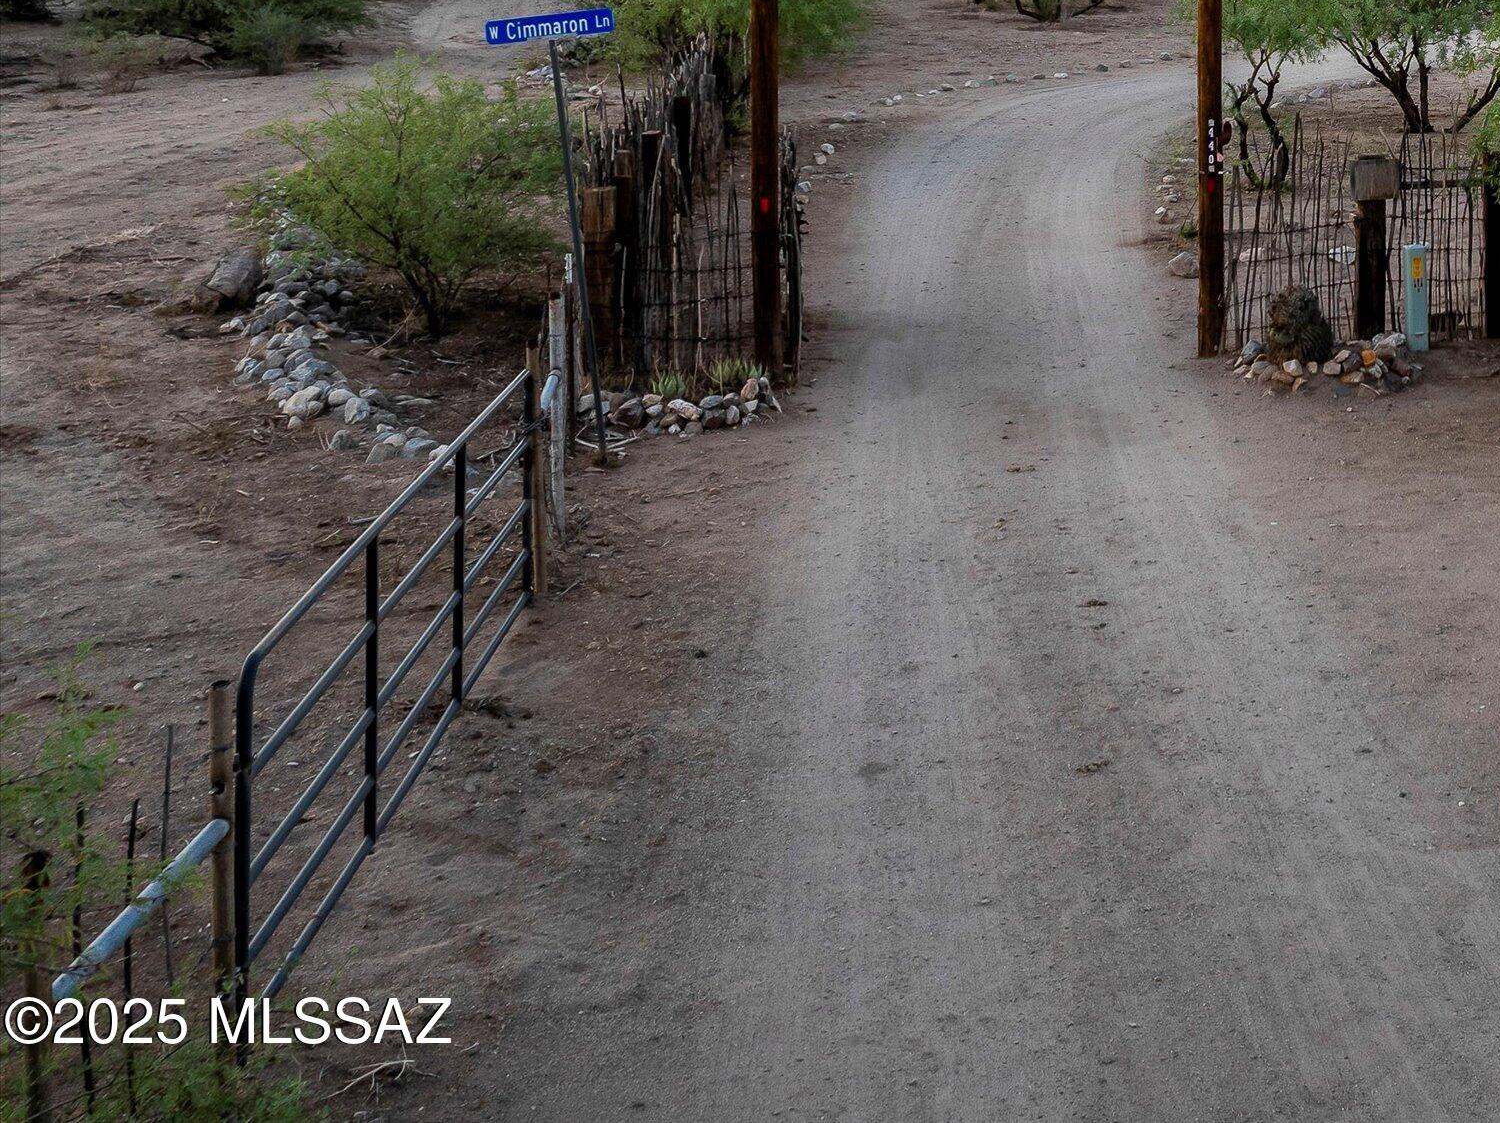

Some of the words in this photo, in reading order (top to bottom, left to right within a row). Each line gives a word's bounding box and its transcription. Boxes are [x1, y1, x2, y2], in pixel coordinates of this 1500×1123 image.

[489, 26, 499, 40] W
[506, 18, 588, 40] Cimmaron
[595, 15, 610, 28] Ln
